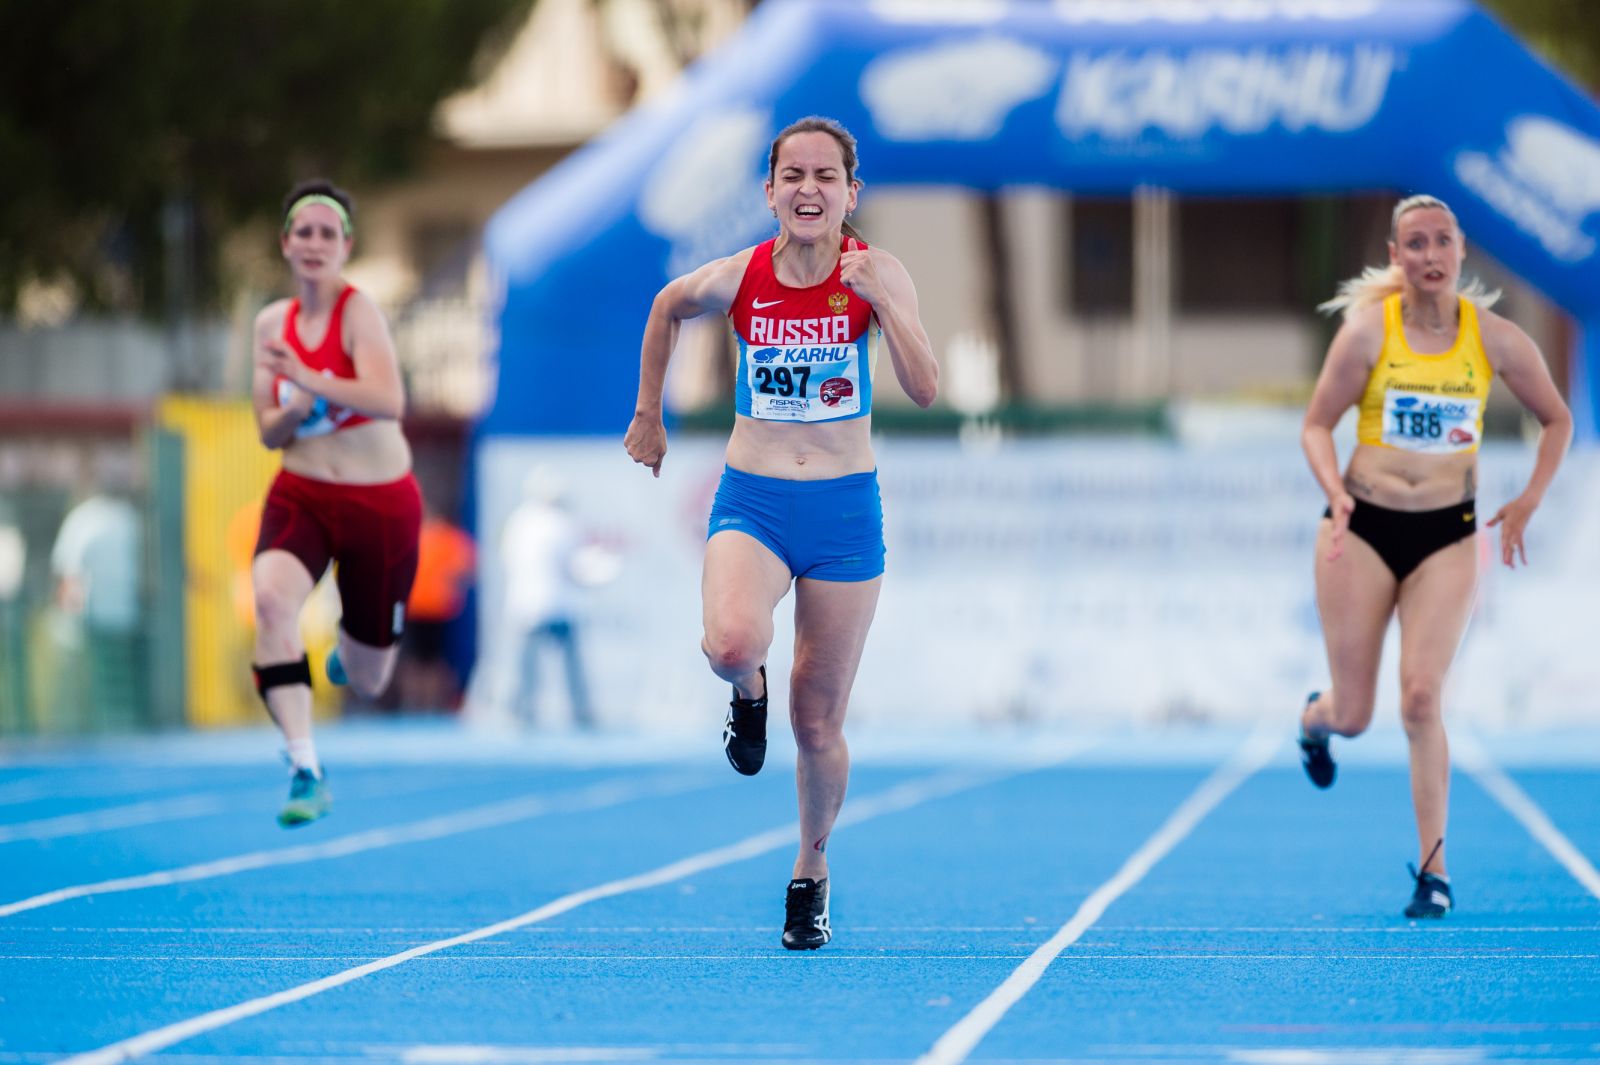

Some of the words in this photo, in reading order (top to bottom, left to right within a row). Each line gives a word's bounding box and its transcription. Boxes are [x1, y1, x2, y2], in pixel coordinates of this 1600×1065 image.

[1055, 46, 1394, 137] KARHU
[750, 315, 849, 344] RUSSIA
[784, 347, 848, 363] KARHU
[756, 366, 811, 398] 297
[769, 398, 801, 406] FISPES
[1394, 411, 1442, 438] 188
